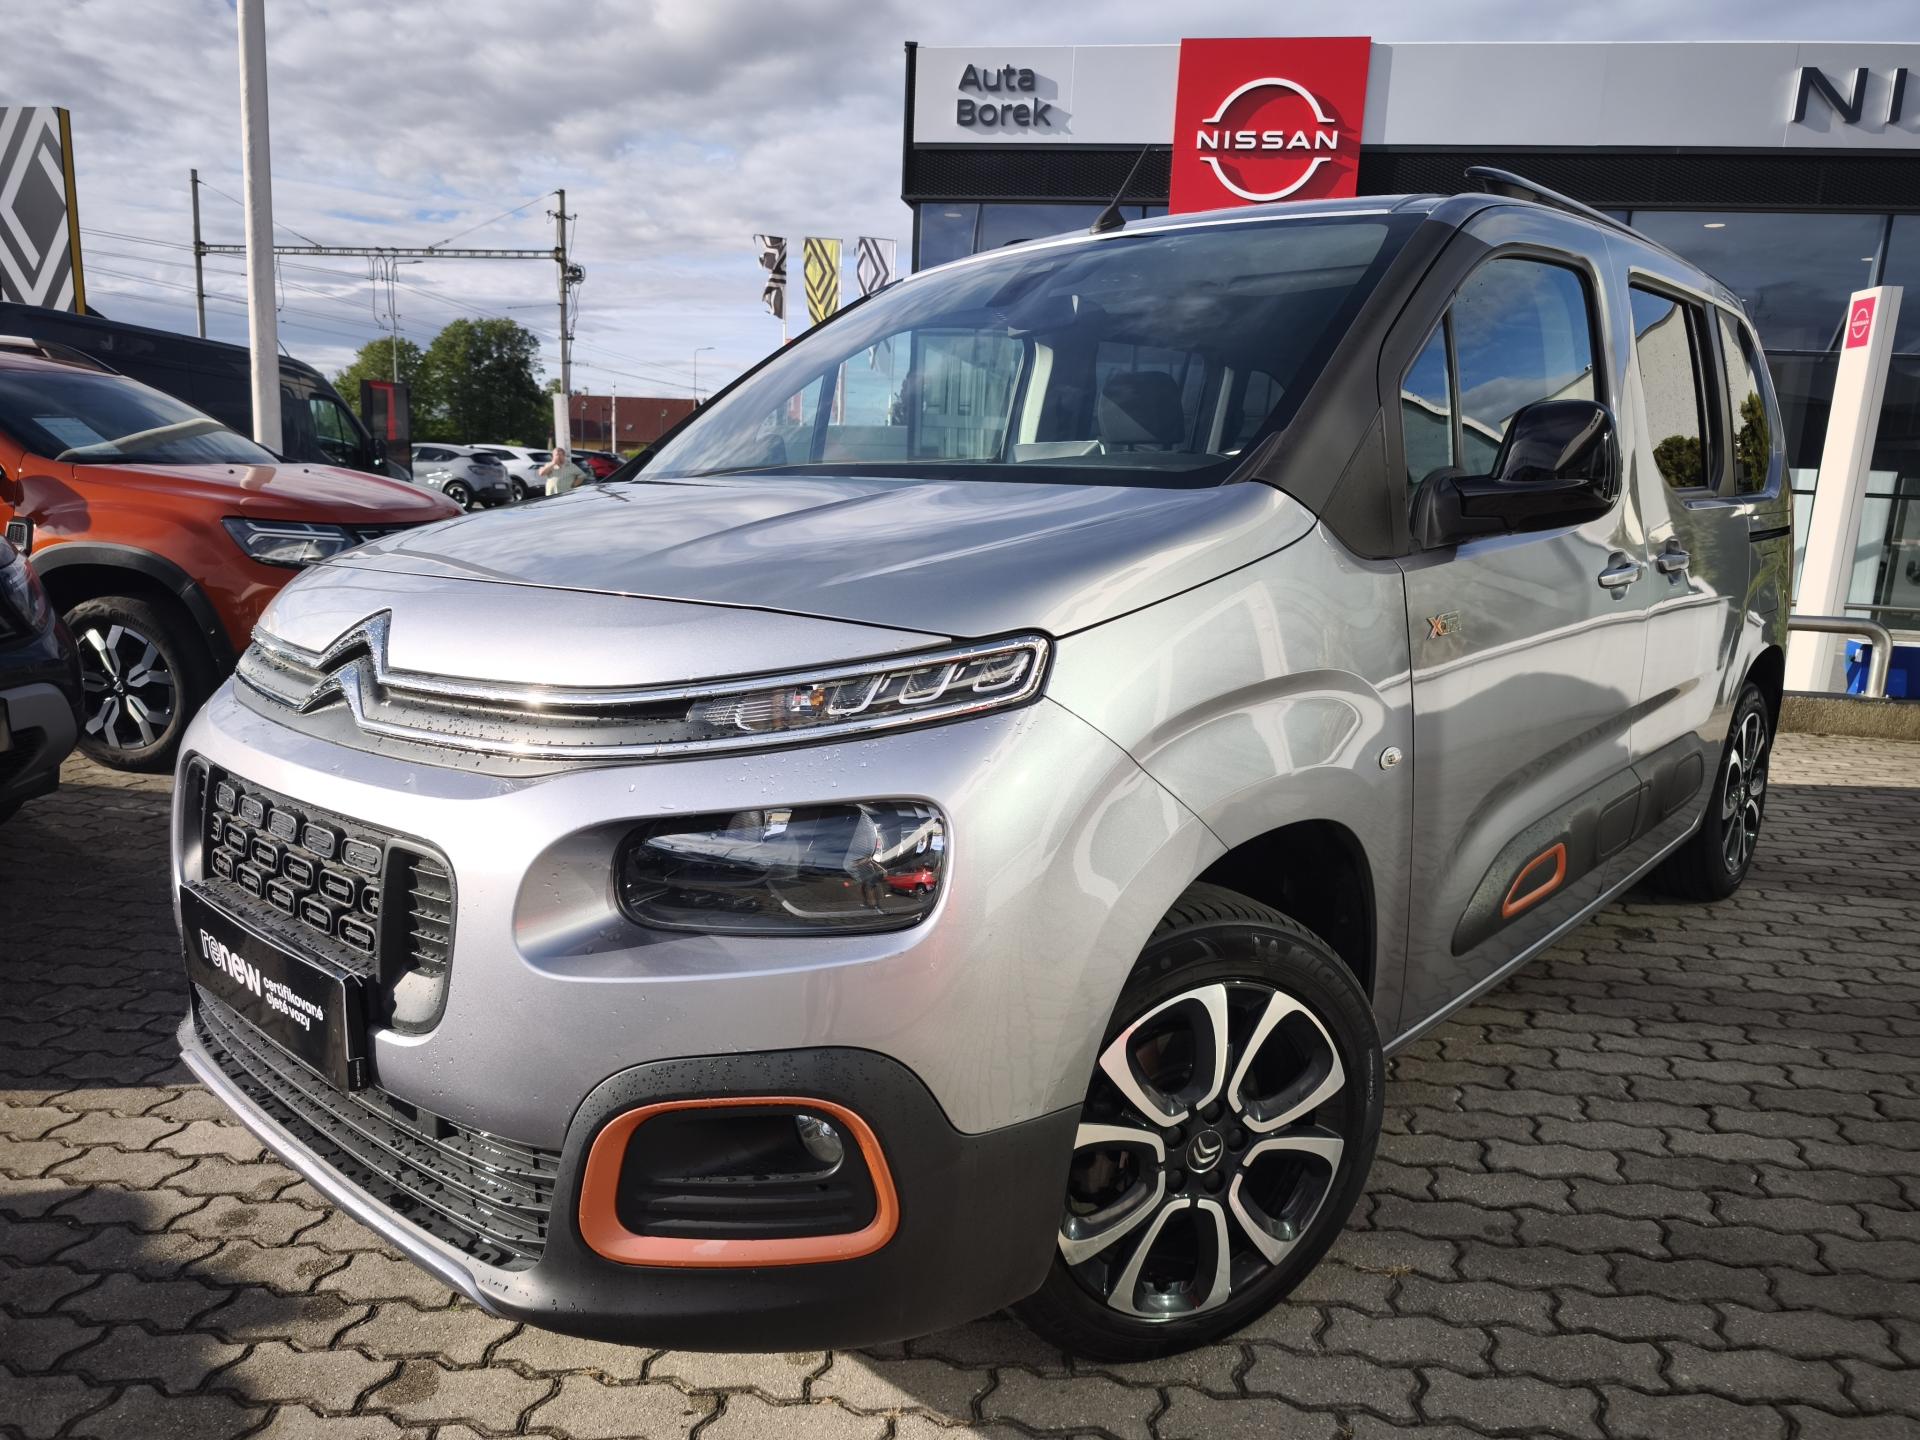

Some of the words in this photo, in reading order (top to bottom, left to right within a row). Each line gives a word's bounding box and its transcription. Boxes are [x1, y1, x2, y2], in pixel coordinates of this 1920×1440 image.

[958, 63, 1036, 92] Auta
[957, 97, 1051, 127] Borek
[1196, 130, 1339, 150] NISSAN
[200, 928, 262, 997] renew
[263, 976, 324, 1021] certifikované
[266, 992, 291, 1015] ojeté
[288, 1005, 311, 1031] vozy
